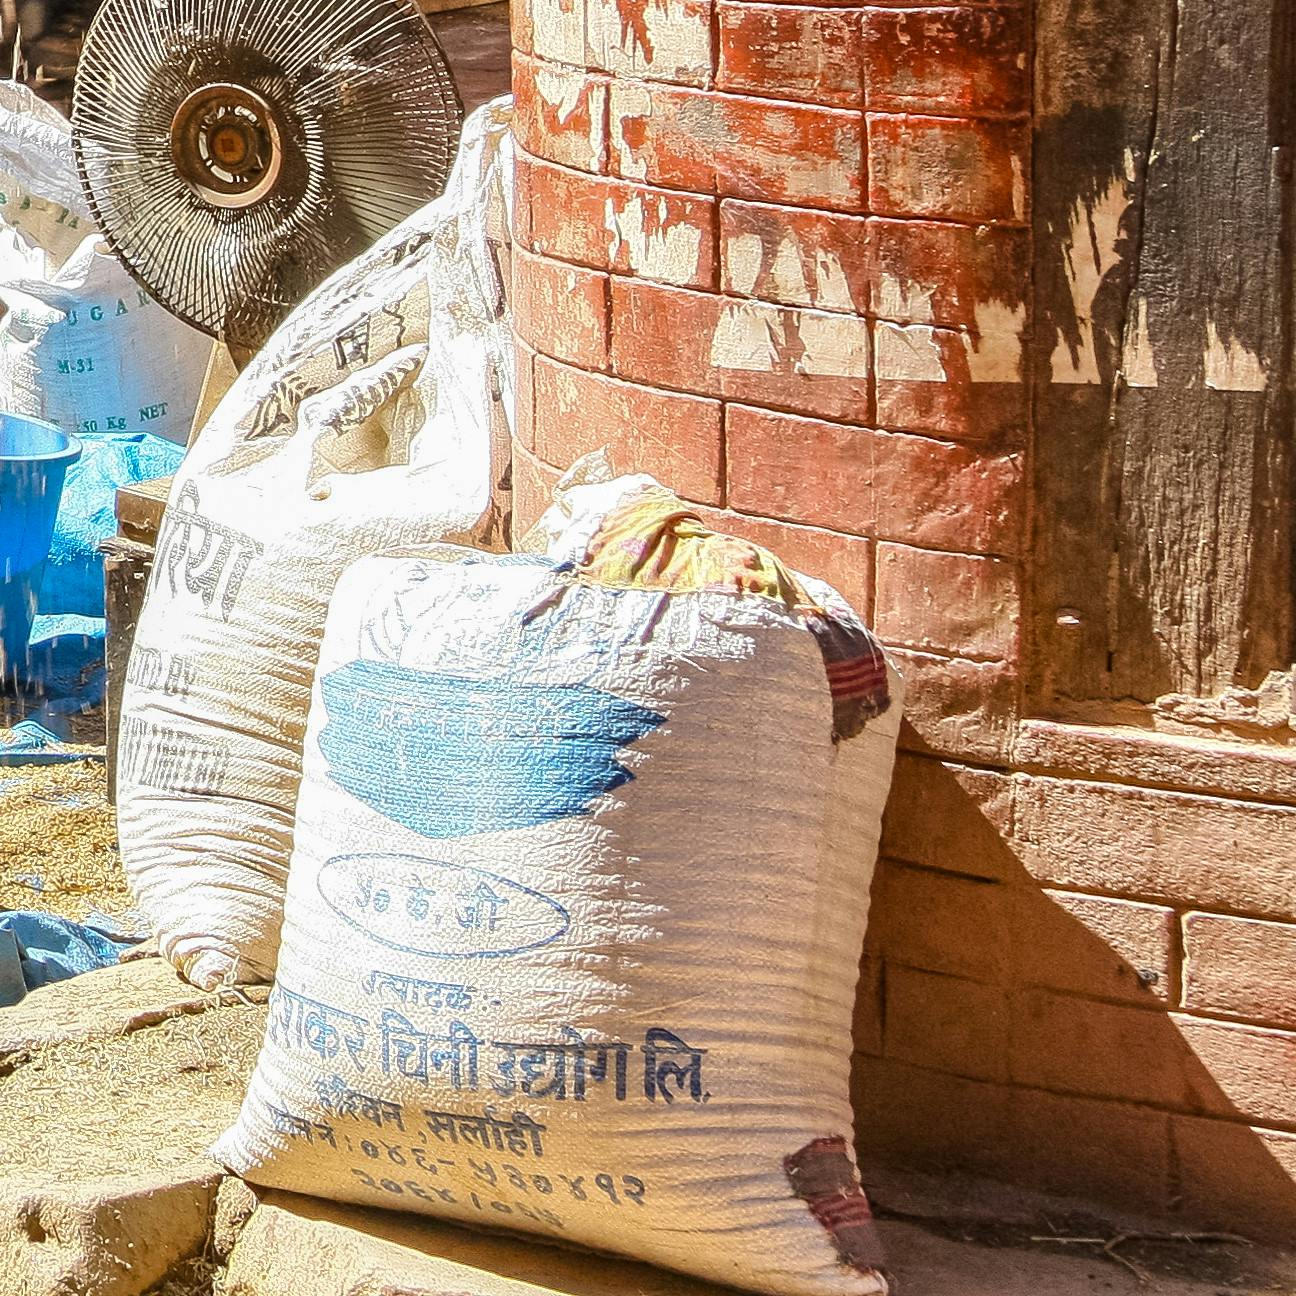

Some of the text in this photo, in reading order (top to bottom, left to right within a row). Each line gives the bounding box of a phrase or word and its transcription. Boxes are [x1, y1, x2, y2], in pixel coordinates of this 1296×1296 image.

[138, 402, 169, 423] NET
[376, 1007, 486, 1092] चिनी
[489, 1025, 633, 1102] उद्योग
[425, 1104, 547, 1158] सर्लाही
